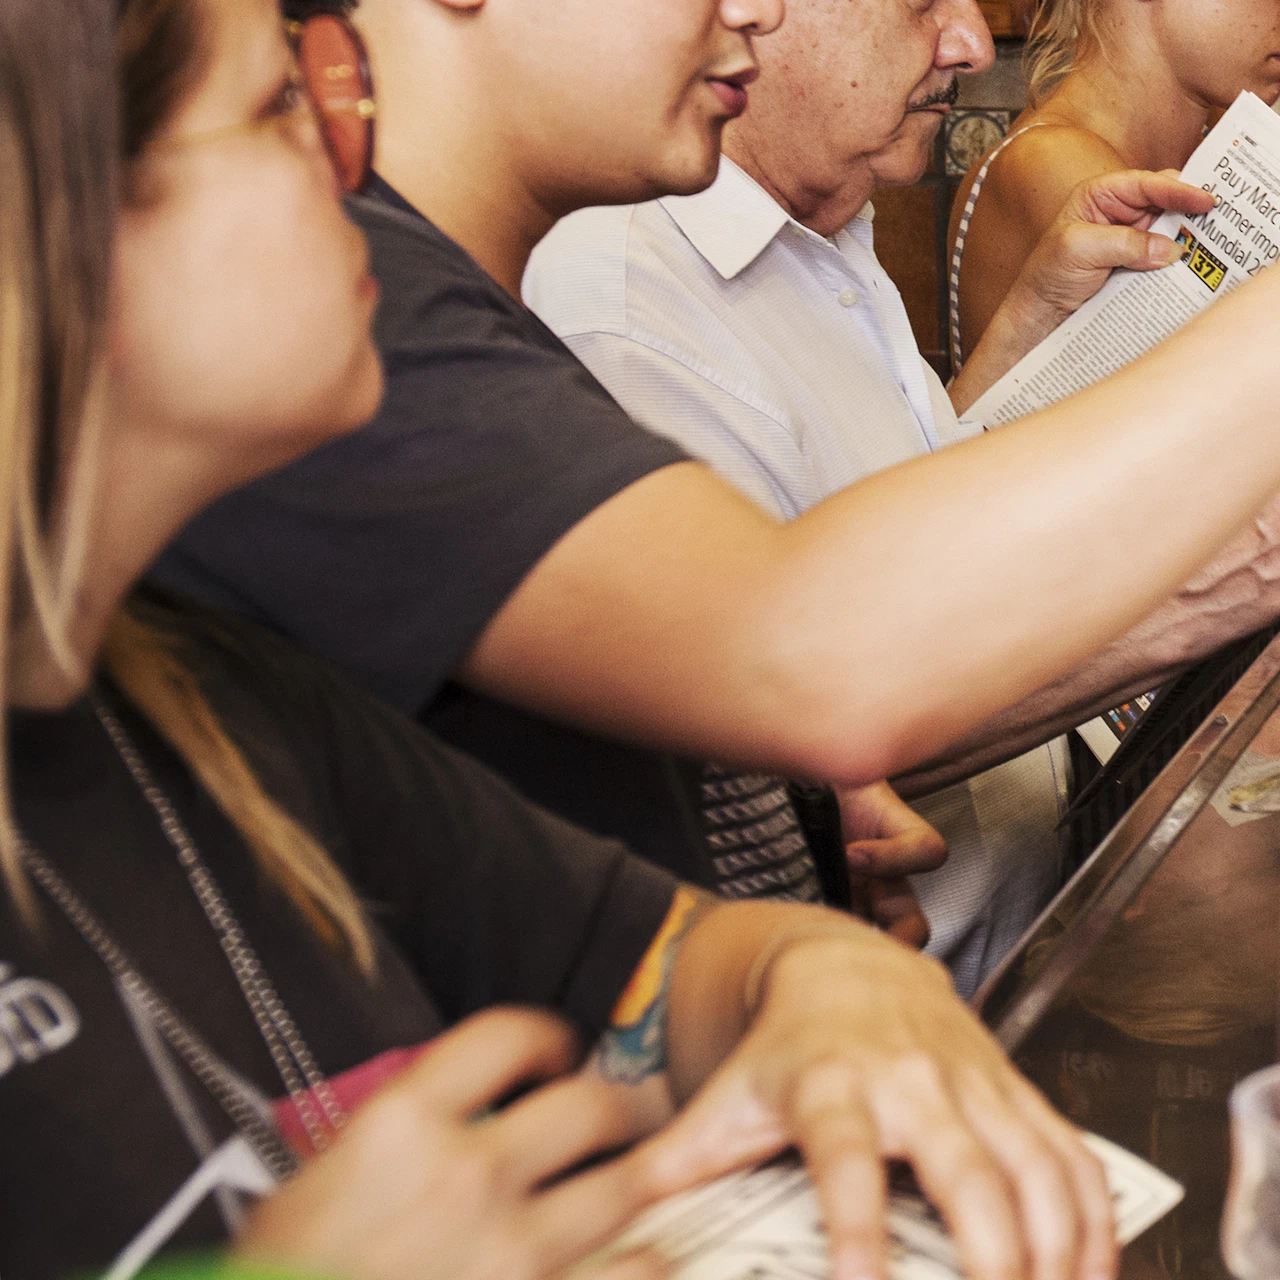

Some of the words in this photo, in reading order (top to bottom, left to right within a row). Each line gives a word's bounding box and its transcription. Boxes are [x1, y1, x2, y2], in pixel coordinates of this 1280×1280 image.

[1212, 156, 1241, 188] Pau
[1235, 181, 1252, 198] y
[1212, 194, 1256, 236] primer
[1199, 211, 1253, 268] Mundial
[1194, 253, 1217, 281] 37
